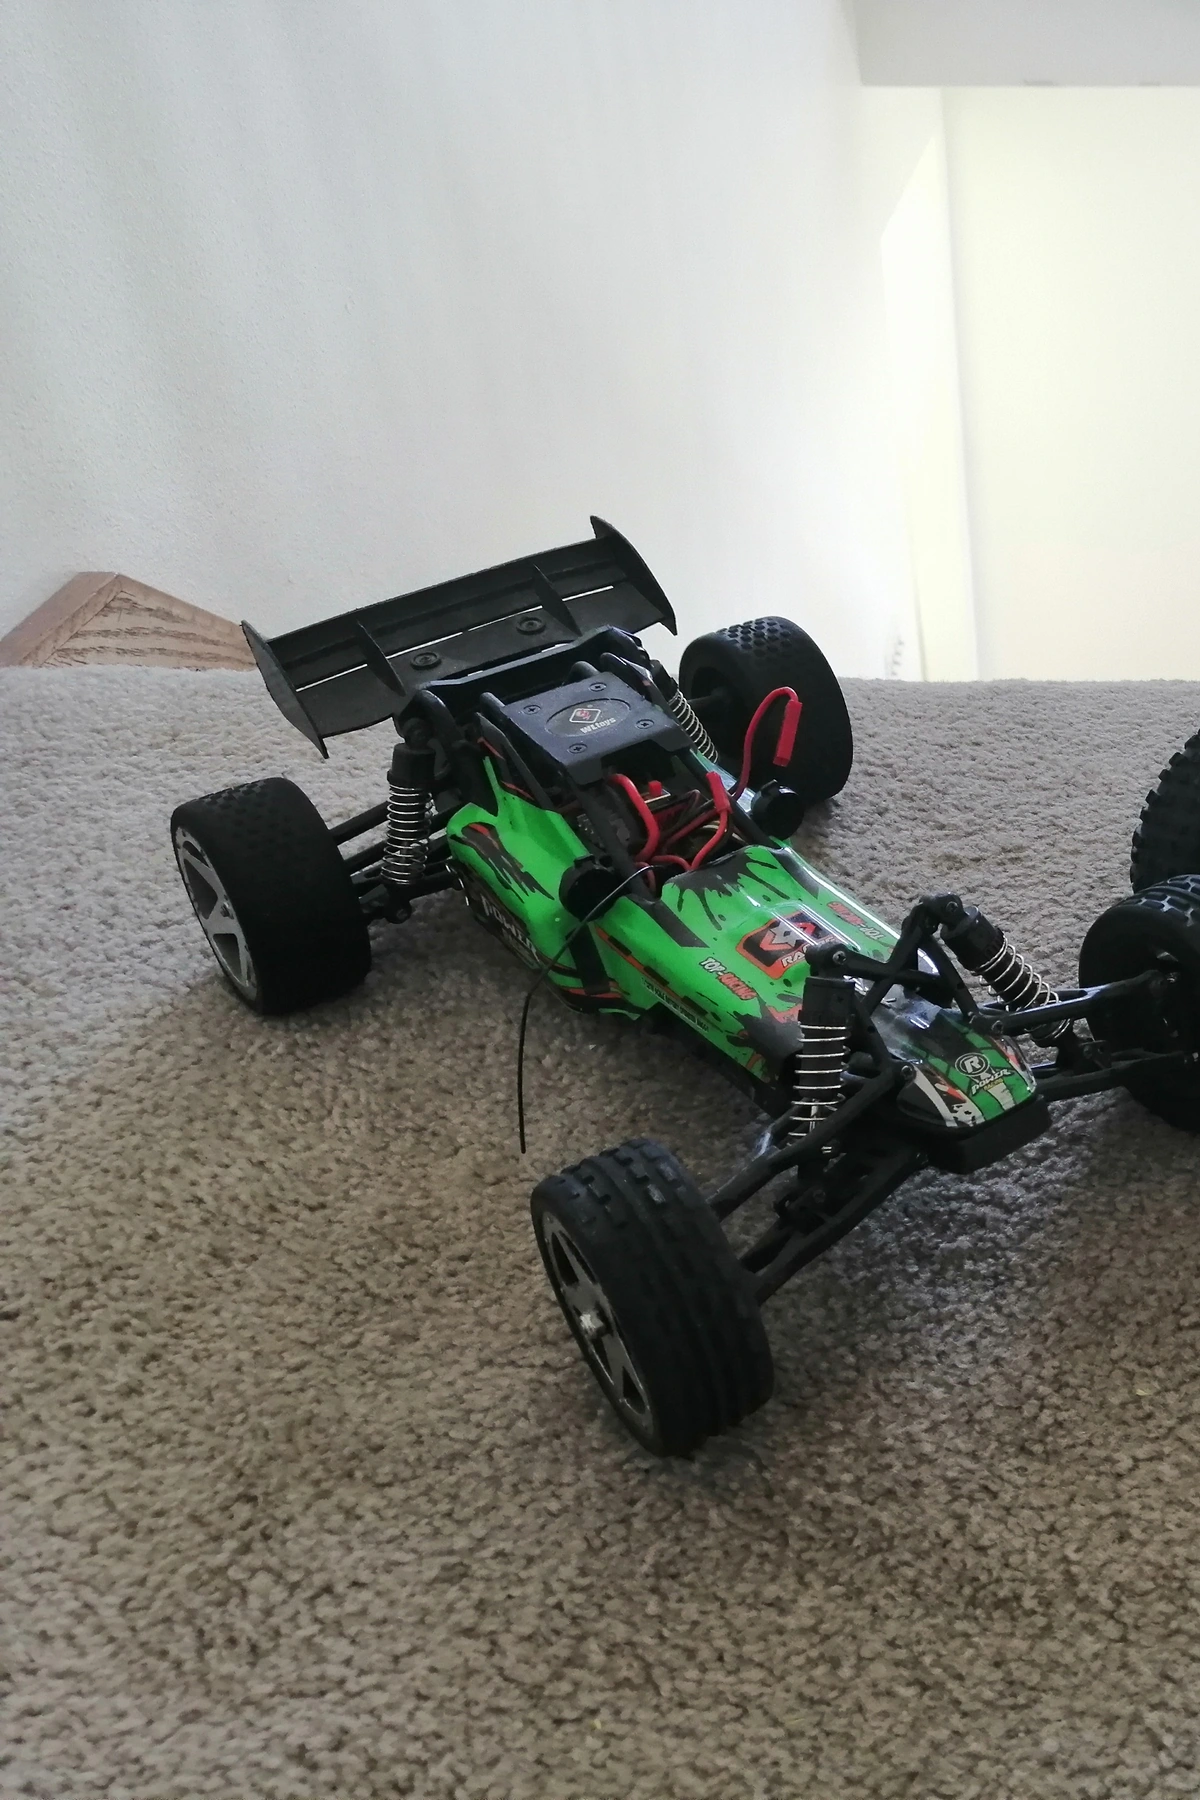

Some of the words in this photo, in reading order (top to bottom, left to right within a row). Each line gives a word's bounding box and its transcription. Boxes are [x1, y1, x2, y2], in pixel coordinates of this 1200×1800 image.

[580, 717, 617, 734] WLtoys
[699, 957, 759, 1001] TOP-RACING
[971, 1068, 1012, 1095] POWER
